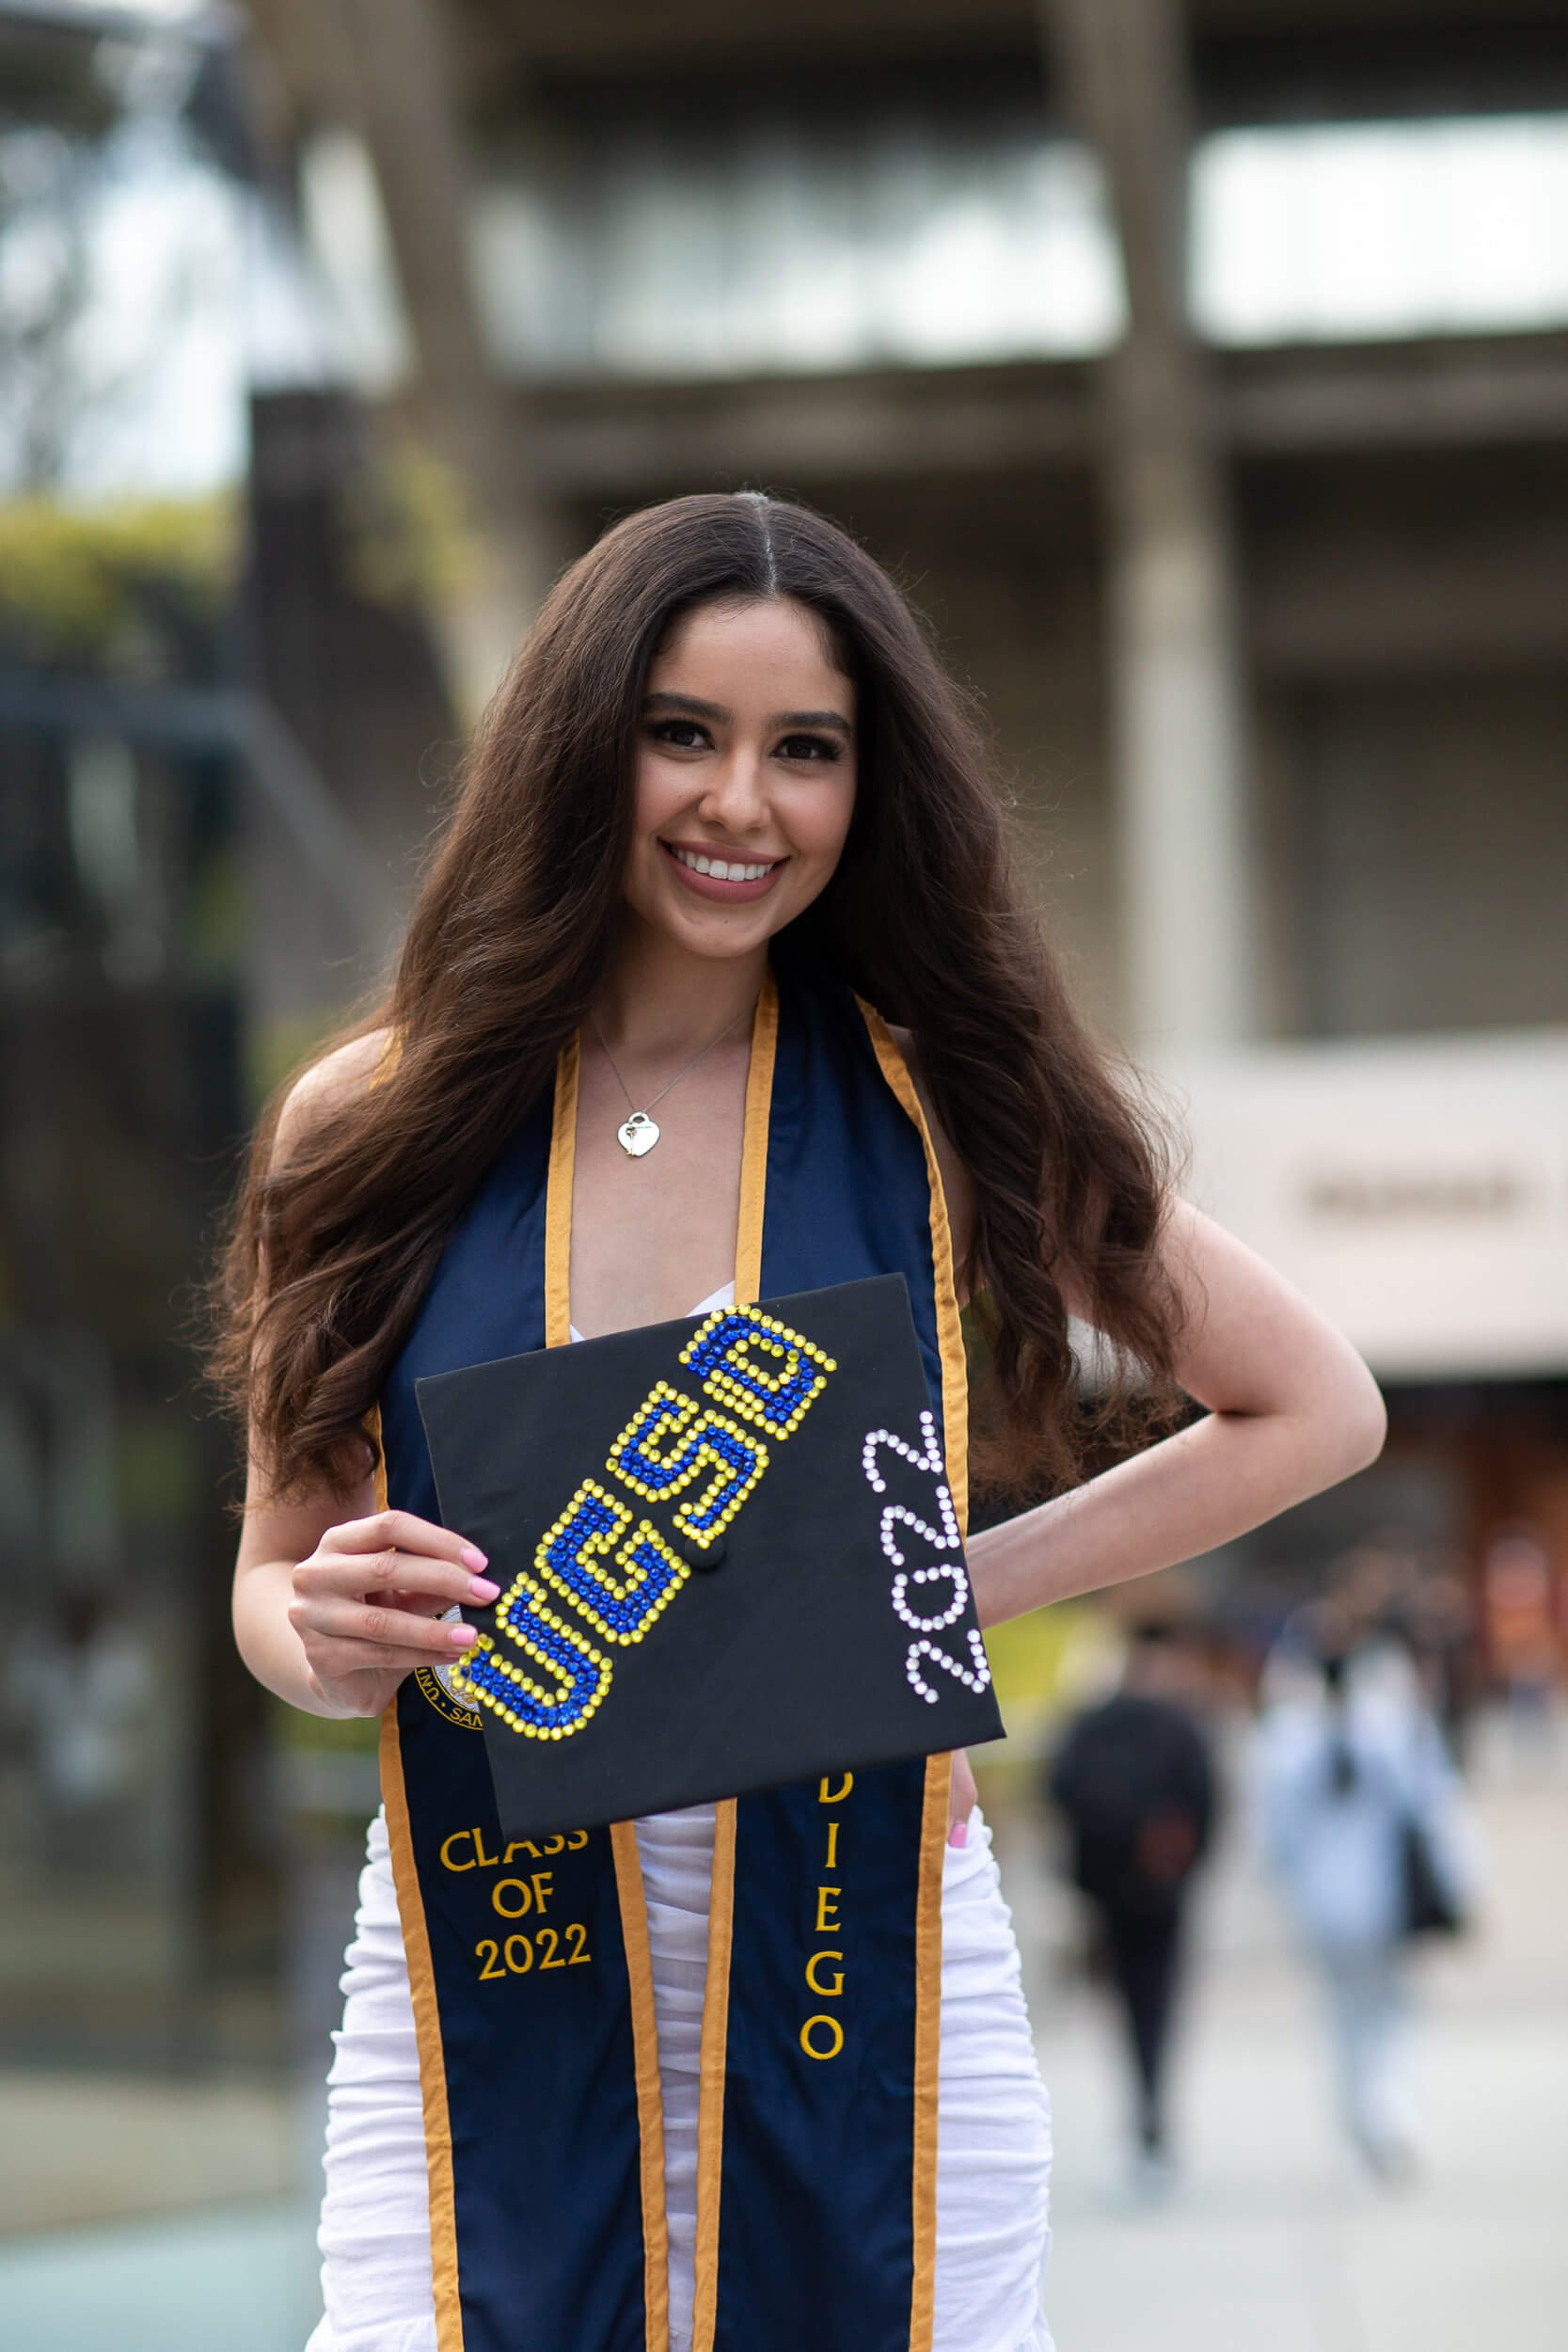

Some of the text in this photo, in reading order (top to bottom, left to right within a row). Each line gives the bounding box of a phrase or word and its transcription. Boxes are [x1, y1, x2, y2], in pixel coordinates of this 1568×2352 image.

[449, 1302, 838, 1740] UCSD
[862, 1410, 991, 1705] 2022
[474, 1923, 593, 1981] 2022
[492, 1871, 554, 1919] OF
[800, 1771, 854, 2060] DIEGO
